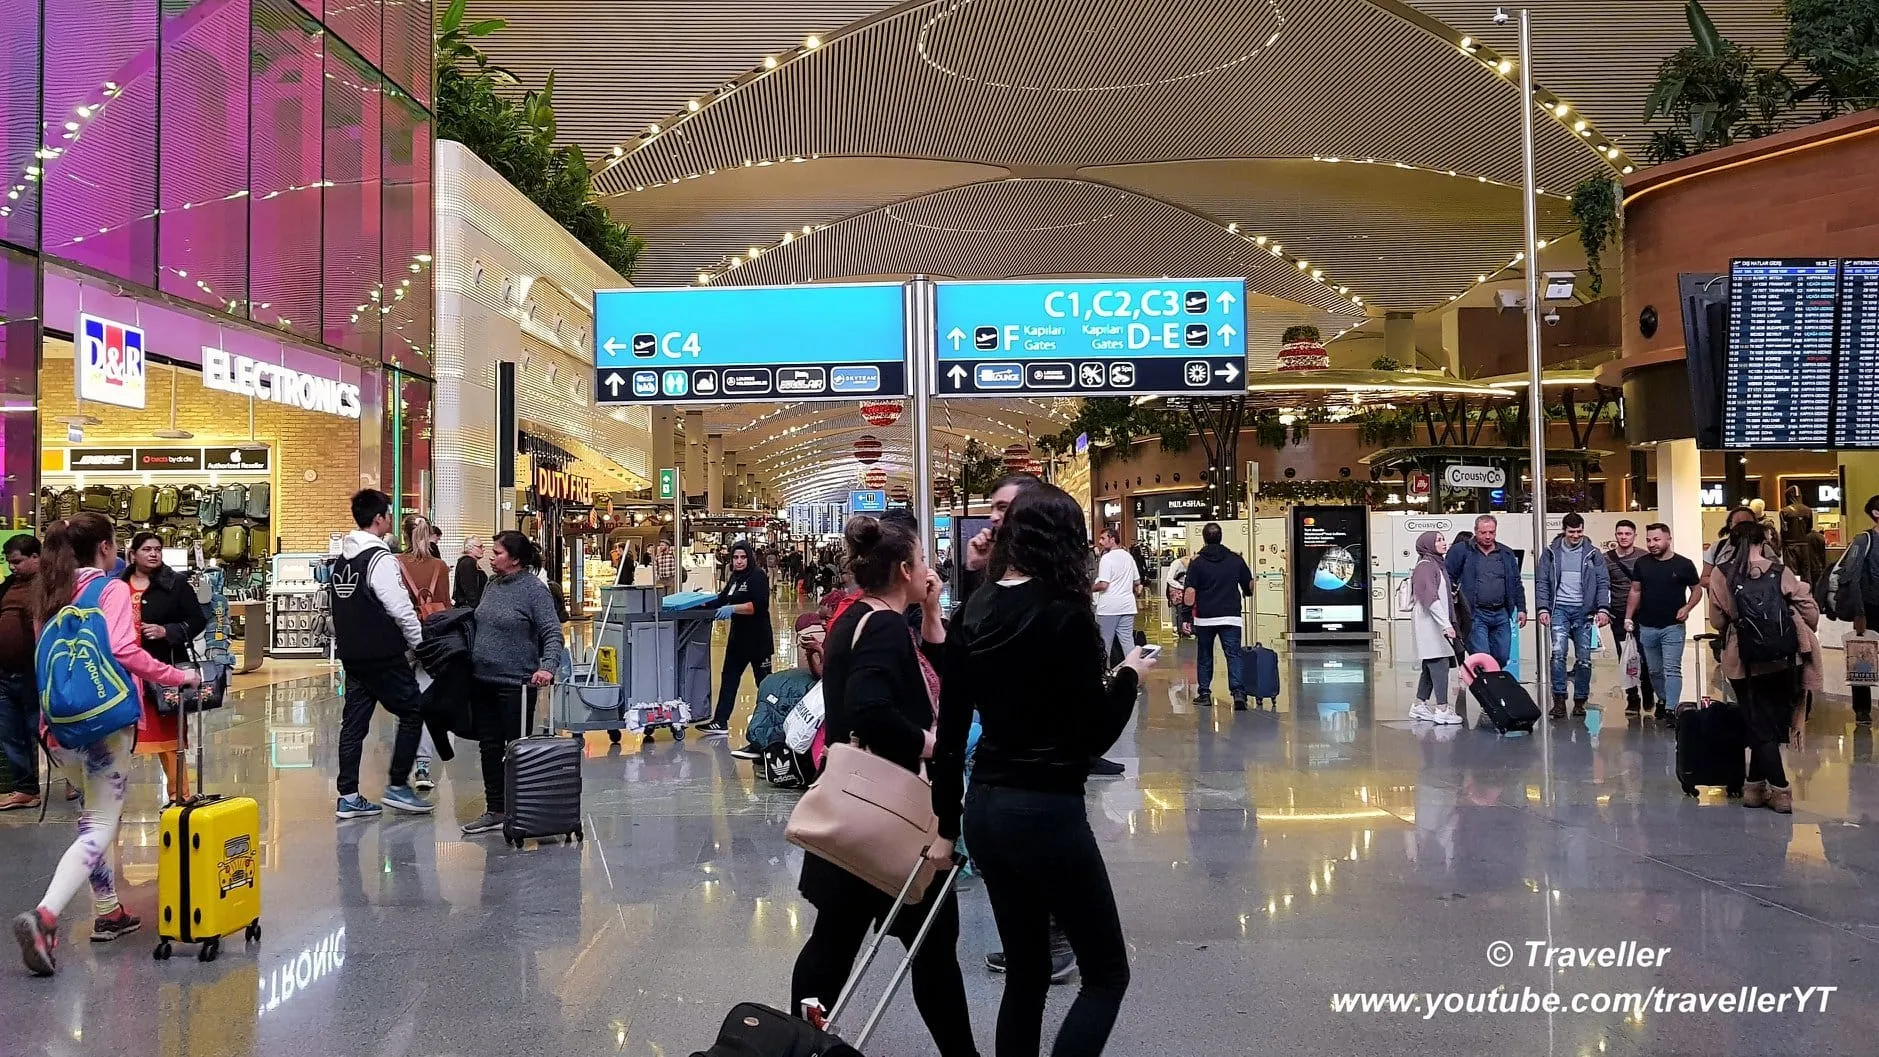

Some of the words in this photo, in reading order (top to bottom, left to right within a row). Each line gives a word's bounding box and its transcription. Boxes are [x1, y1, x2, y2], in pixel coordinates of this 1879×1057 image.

[1044, 290, 1180, 321] C1,C2,C3
[661, 331, 702, 359] C4
[1004, 325, 1020, 351] F
[1024, 339, 1057, 351] Gates
[1092, 339, 1124, 351] Gates
[1127, 323, 1180, 350] D-E
[86, 327, 142, 381] D&R
[201, 345, 362, 419] ELECTRONICS
[539, 468, 569, 499] DUTY
[84, 659, 106, 698] Reebok
